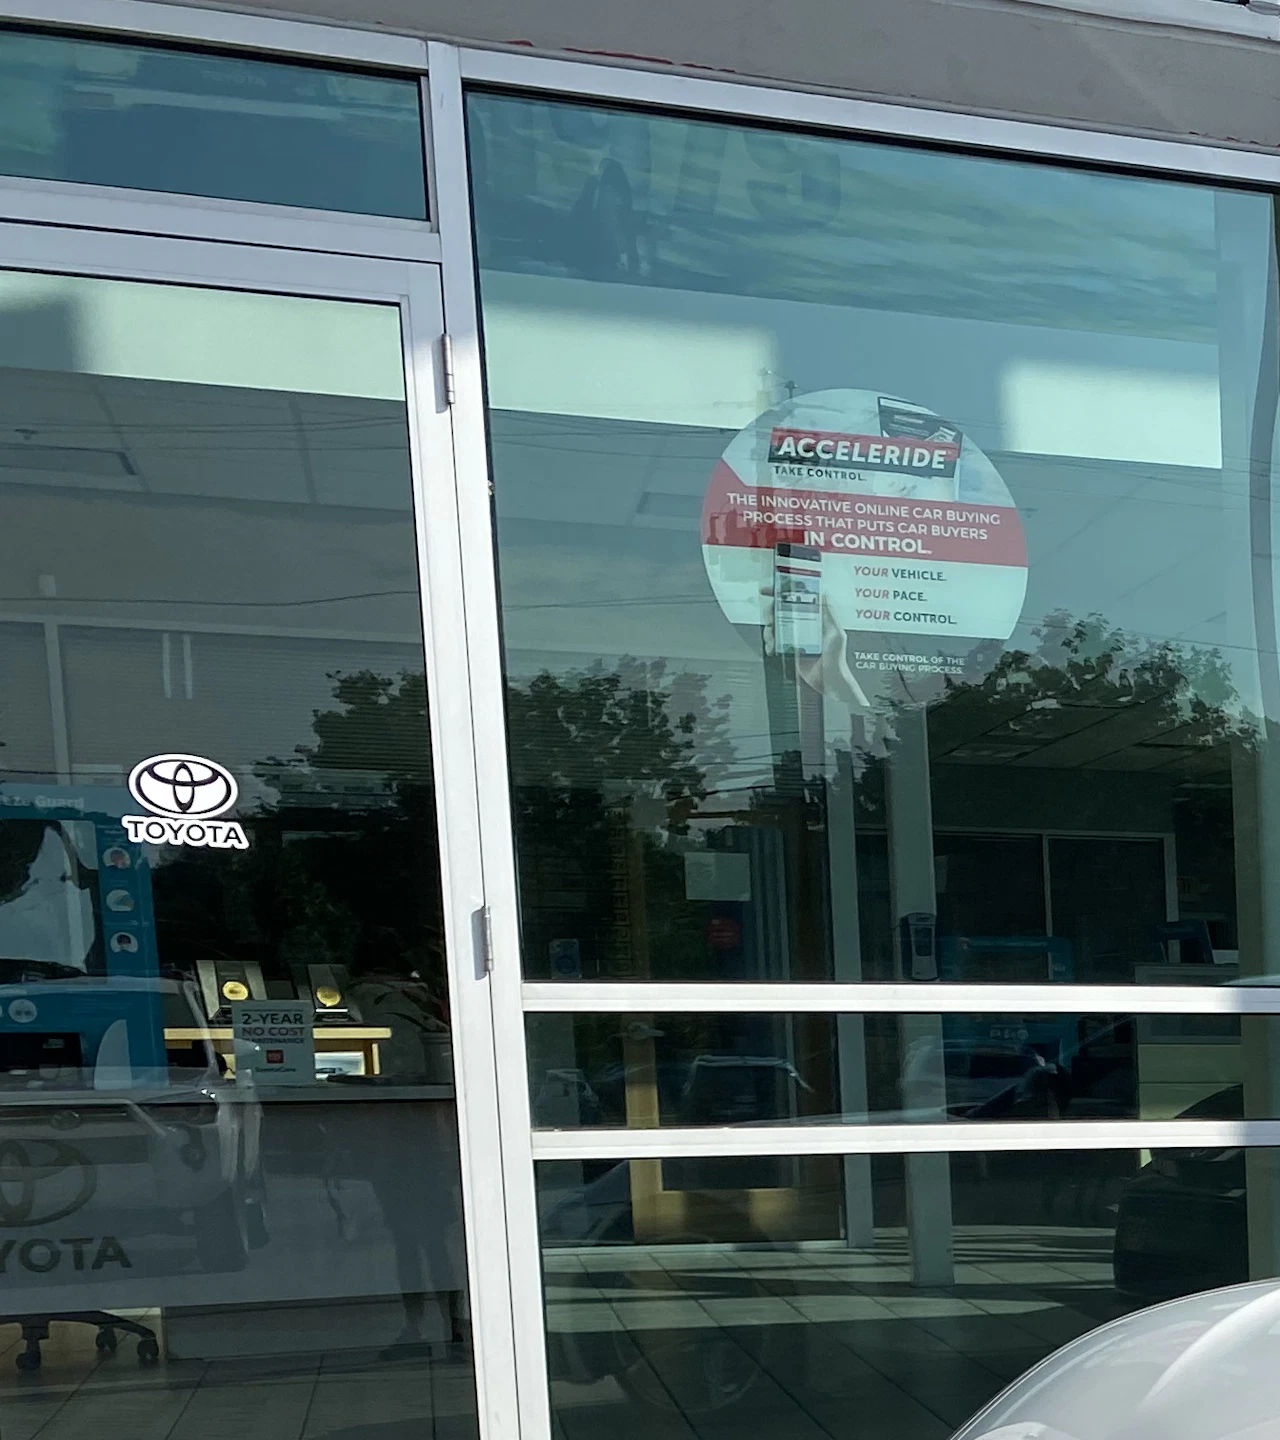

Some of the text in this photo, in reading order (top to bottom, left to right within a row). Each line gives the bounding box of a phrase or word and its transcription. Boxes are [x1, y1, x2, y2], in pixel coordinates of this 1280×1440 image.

[774, 466, 803, 477] TAKE
[727, 493, 1001, 525] THE INNOVATIVE ONLINE CAR BUYING
[743, 510, 988, 540] PROCESS THAT PUTS CAR BUYERS
[804, 531, 825, 546] IN
[854, 566, 889, 577] YOUR
[855, 588, 890, 599] YOUR
[856, 609, 891, 621] YOUR
[854, 652, 966, 666] TAKE CONTROL OF THE
[855, 662, 876, 670] CAR
[879, 663, 916, 672] BUYING
[128, 820, 243, 845] TOYOTA
[241, 1013, 304, 1025] 2-YEAR
[242, 1027, 305, 1037] NO COST
